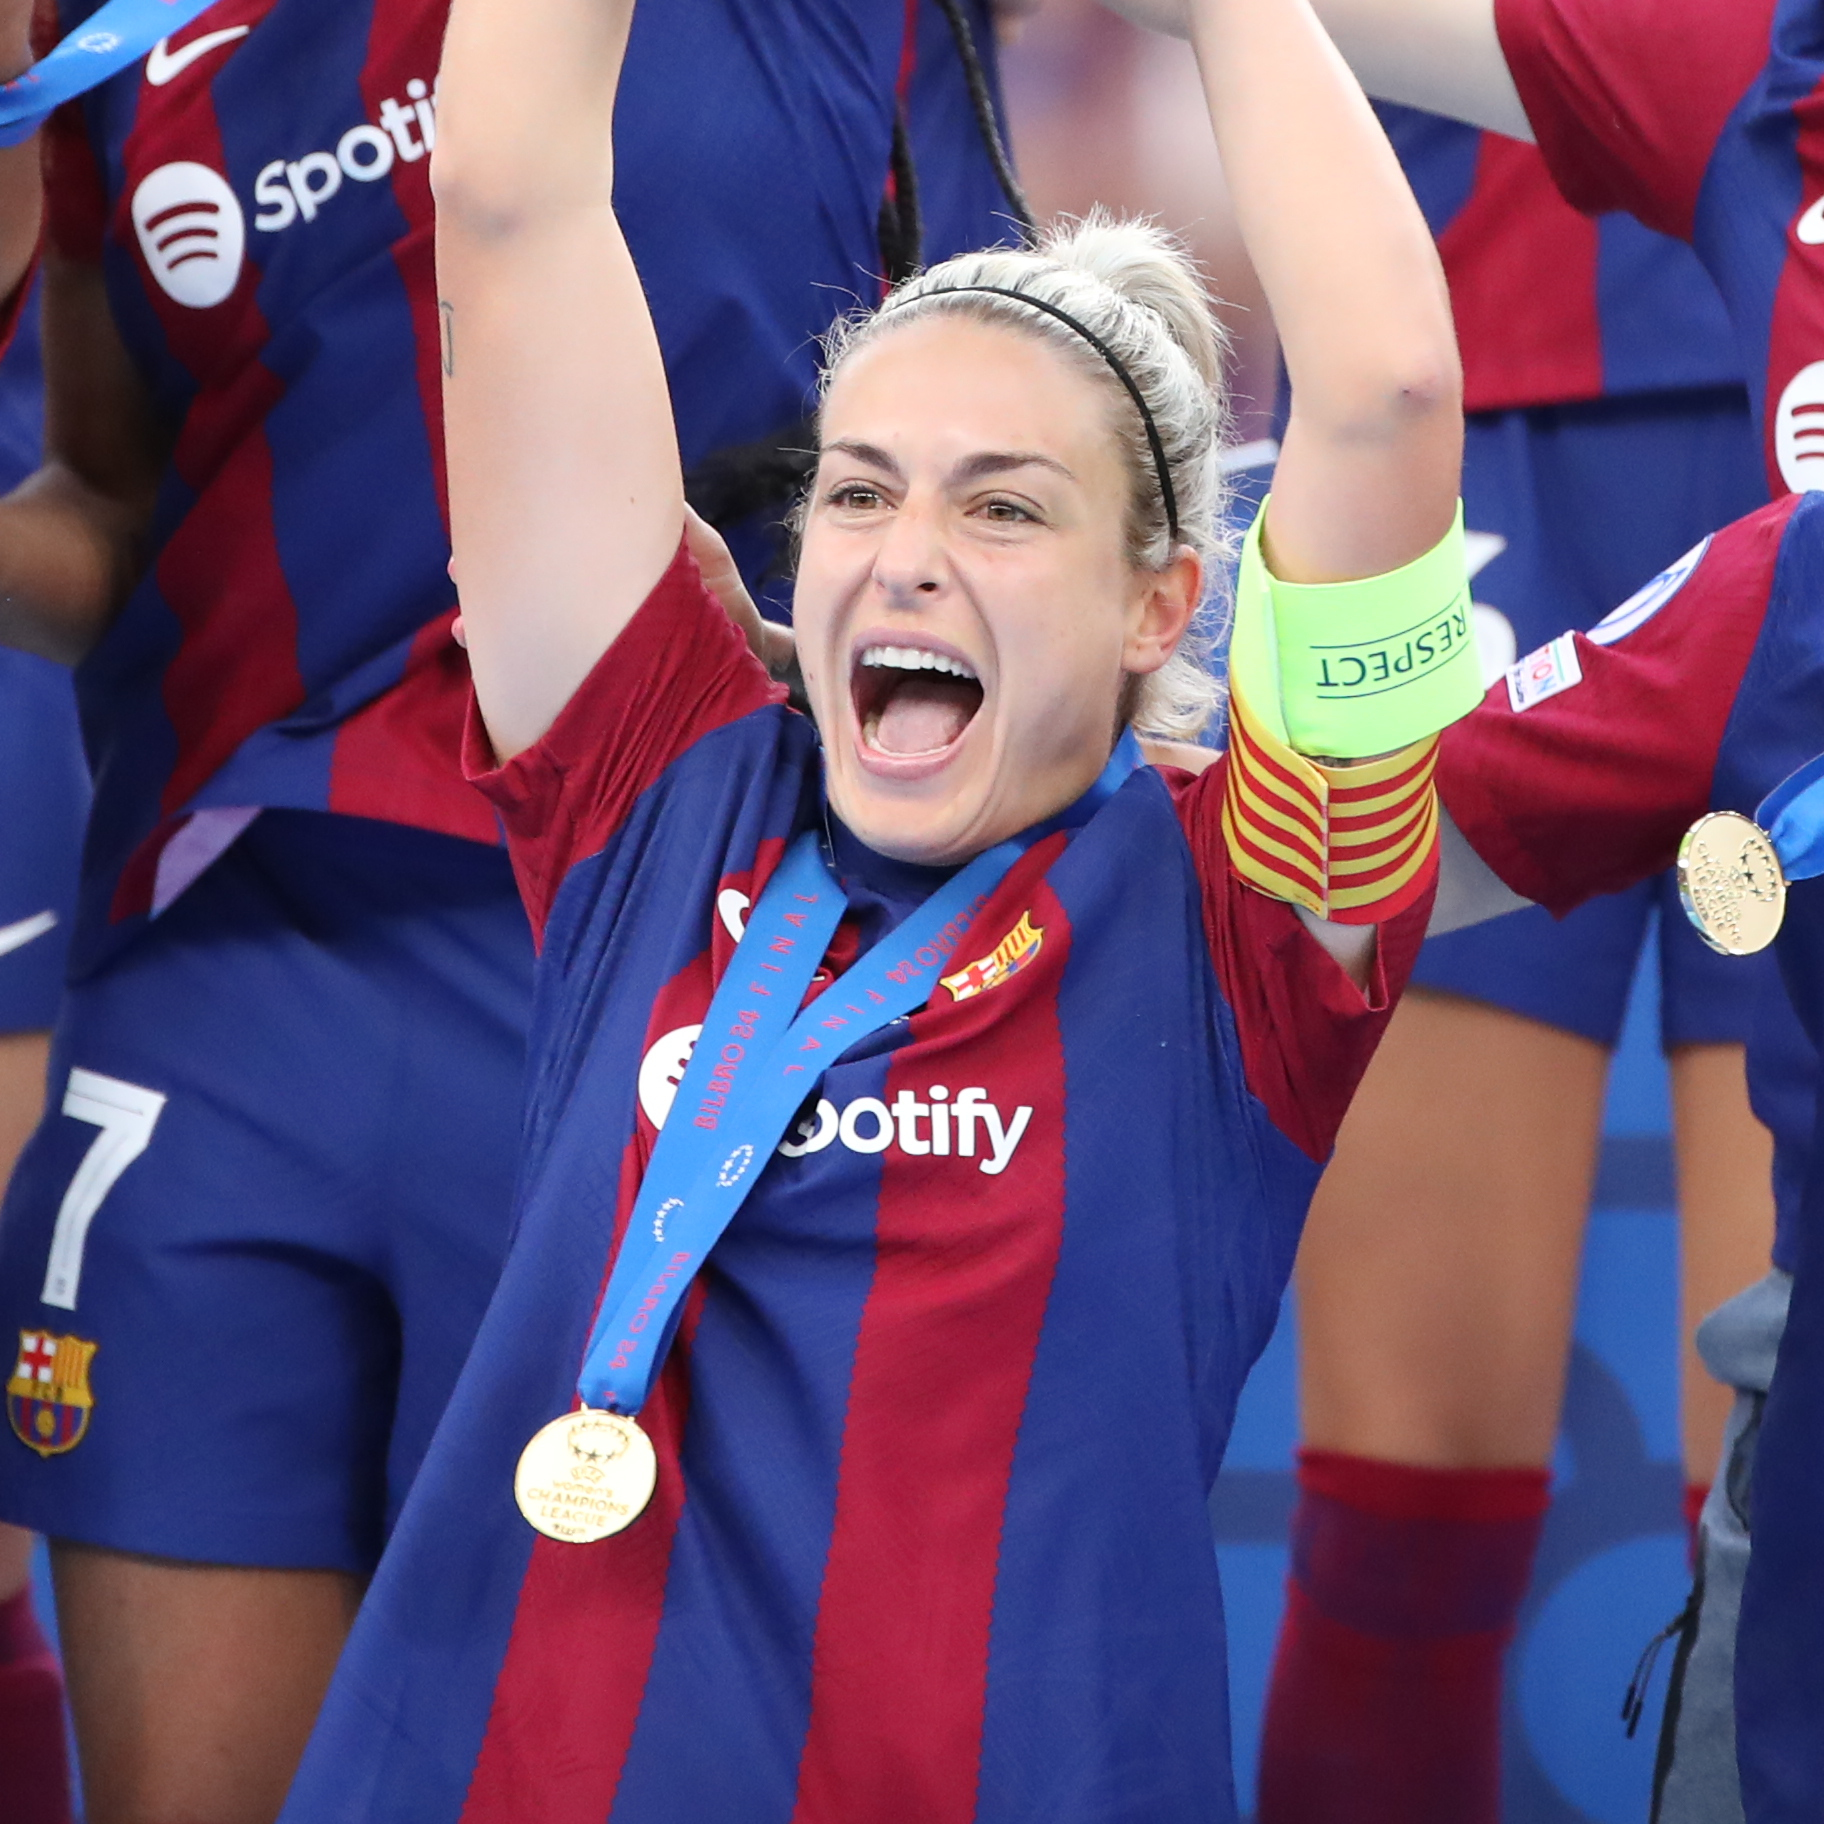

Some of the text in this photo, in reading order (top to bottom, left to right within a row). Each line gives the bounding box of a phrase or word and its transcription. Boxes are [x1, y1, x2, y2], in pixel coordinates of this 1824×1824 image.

[1316, 603, 1469, 688] RESPECT
[692, 891, 820, 1131] BILBAO 24 FINAL
[885, 959, 917, 985] 24
[782, 988, 887, 1075] FINAL
[39, 1068, 166, 1311] 7
[608, 1251, 692, 1370] BILBAO 24
[526, 1487, 629, 1516] CHAMPIONS
[539, 1505, 607, 1527] LEAGUE
